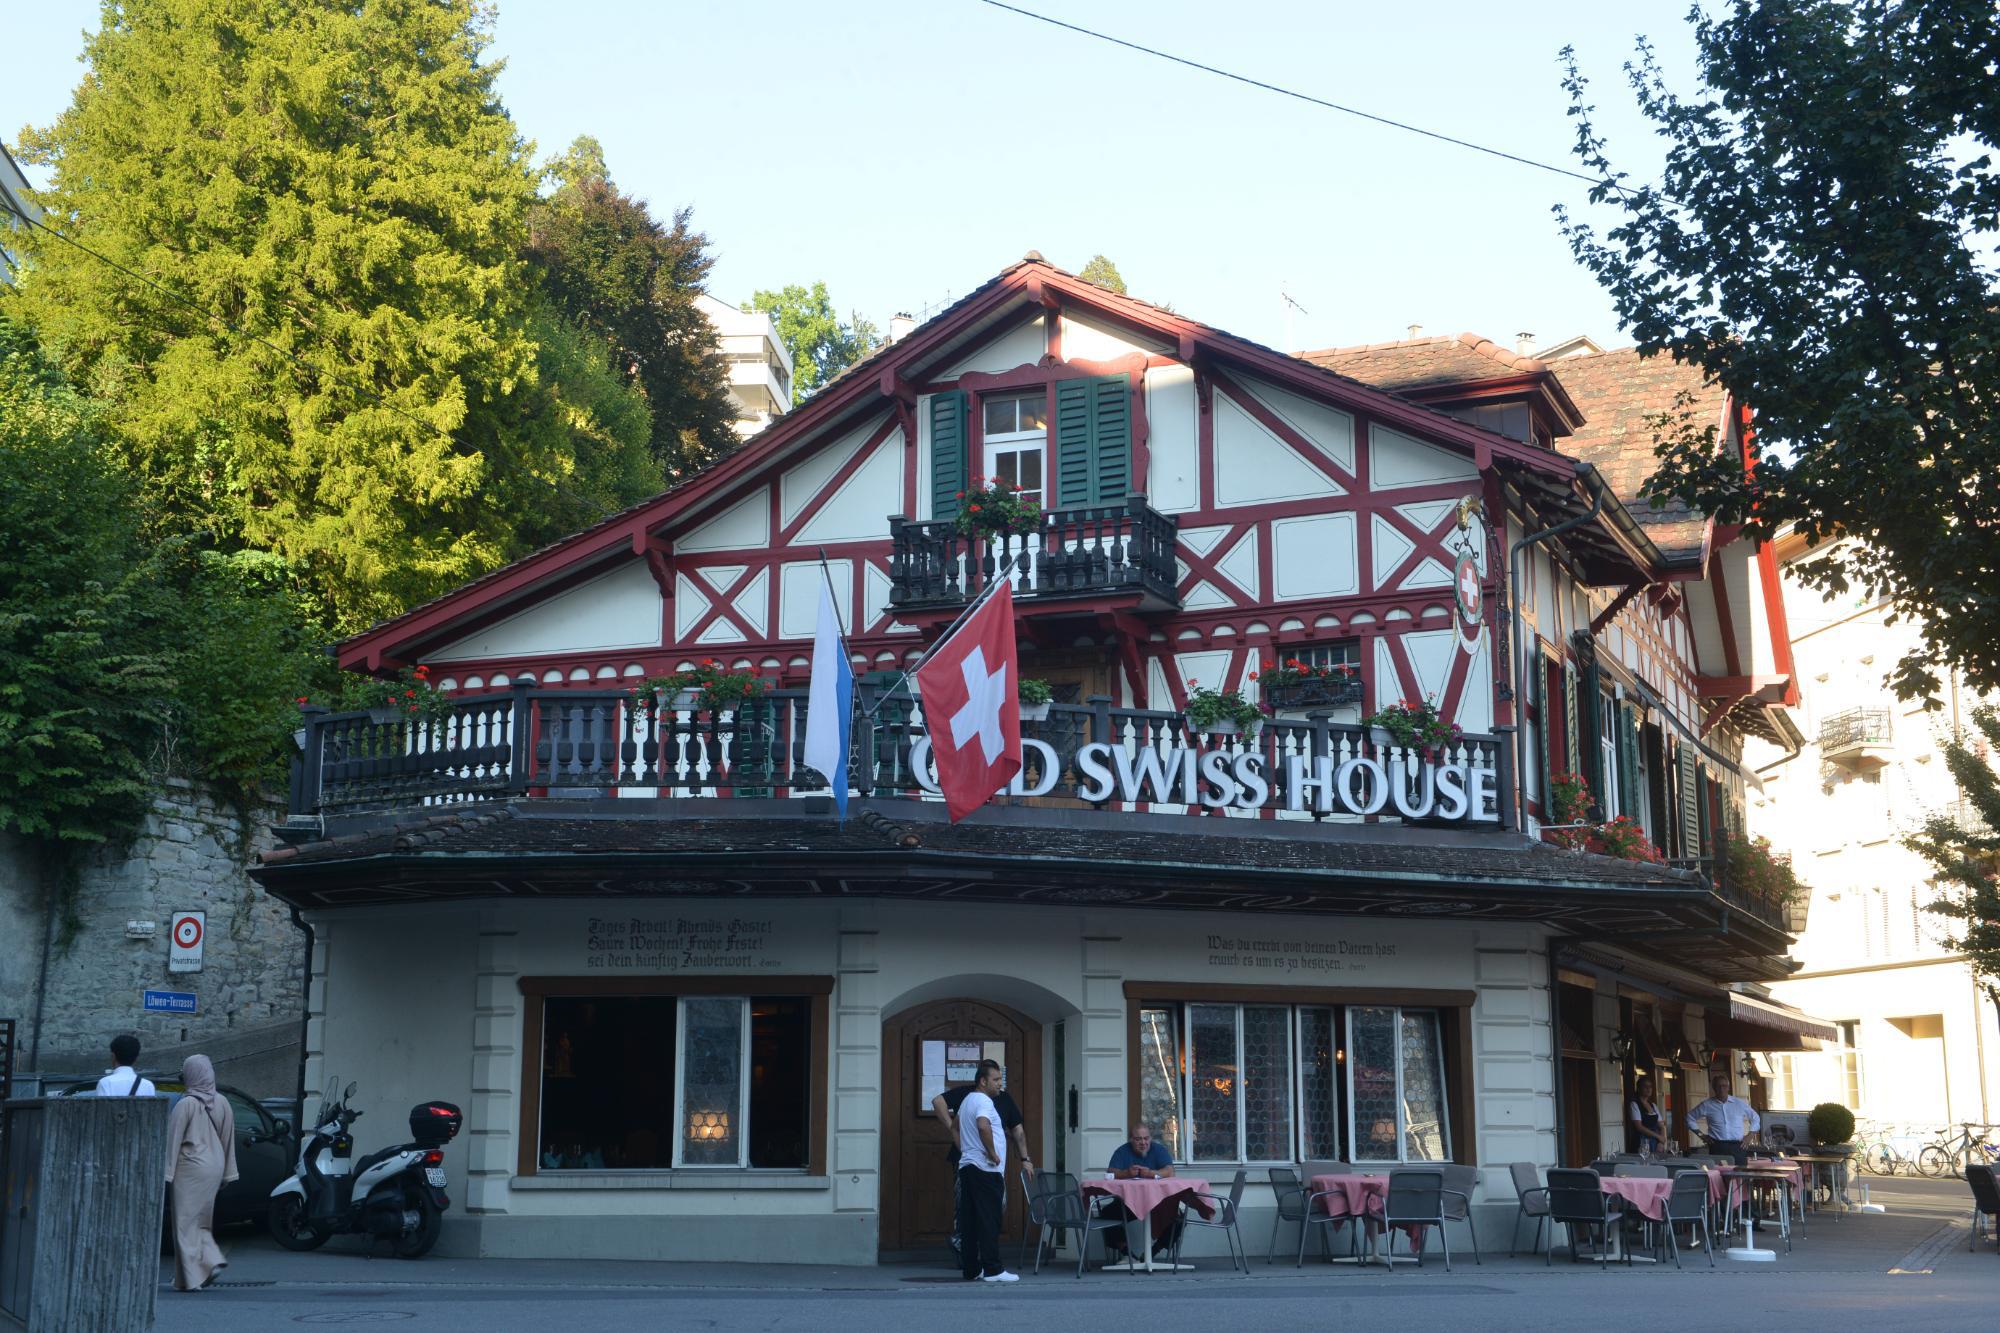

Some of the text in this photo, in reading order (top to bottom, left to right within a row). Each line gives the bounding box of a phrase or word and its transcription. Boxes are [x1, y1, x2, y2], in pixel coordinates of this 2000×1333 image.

[1076, 742, 1269, 810] SWISS
[1284, 754, 1500, 822] HOUSE
[1207, 935, 1234, 951] Was
[147, 995, 194, 1009] Löwen-Terrasse
